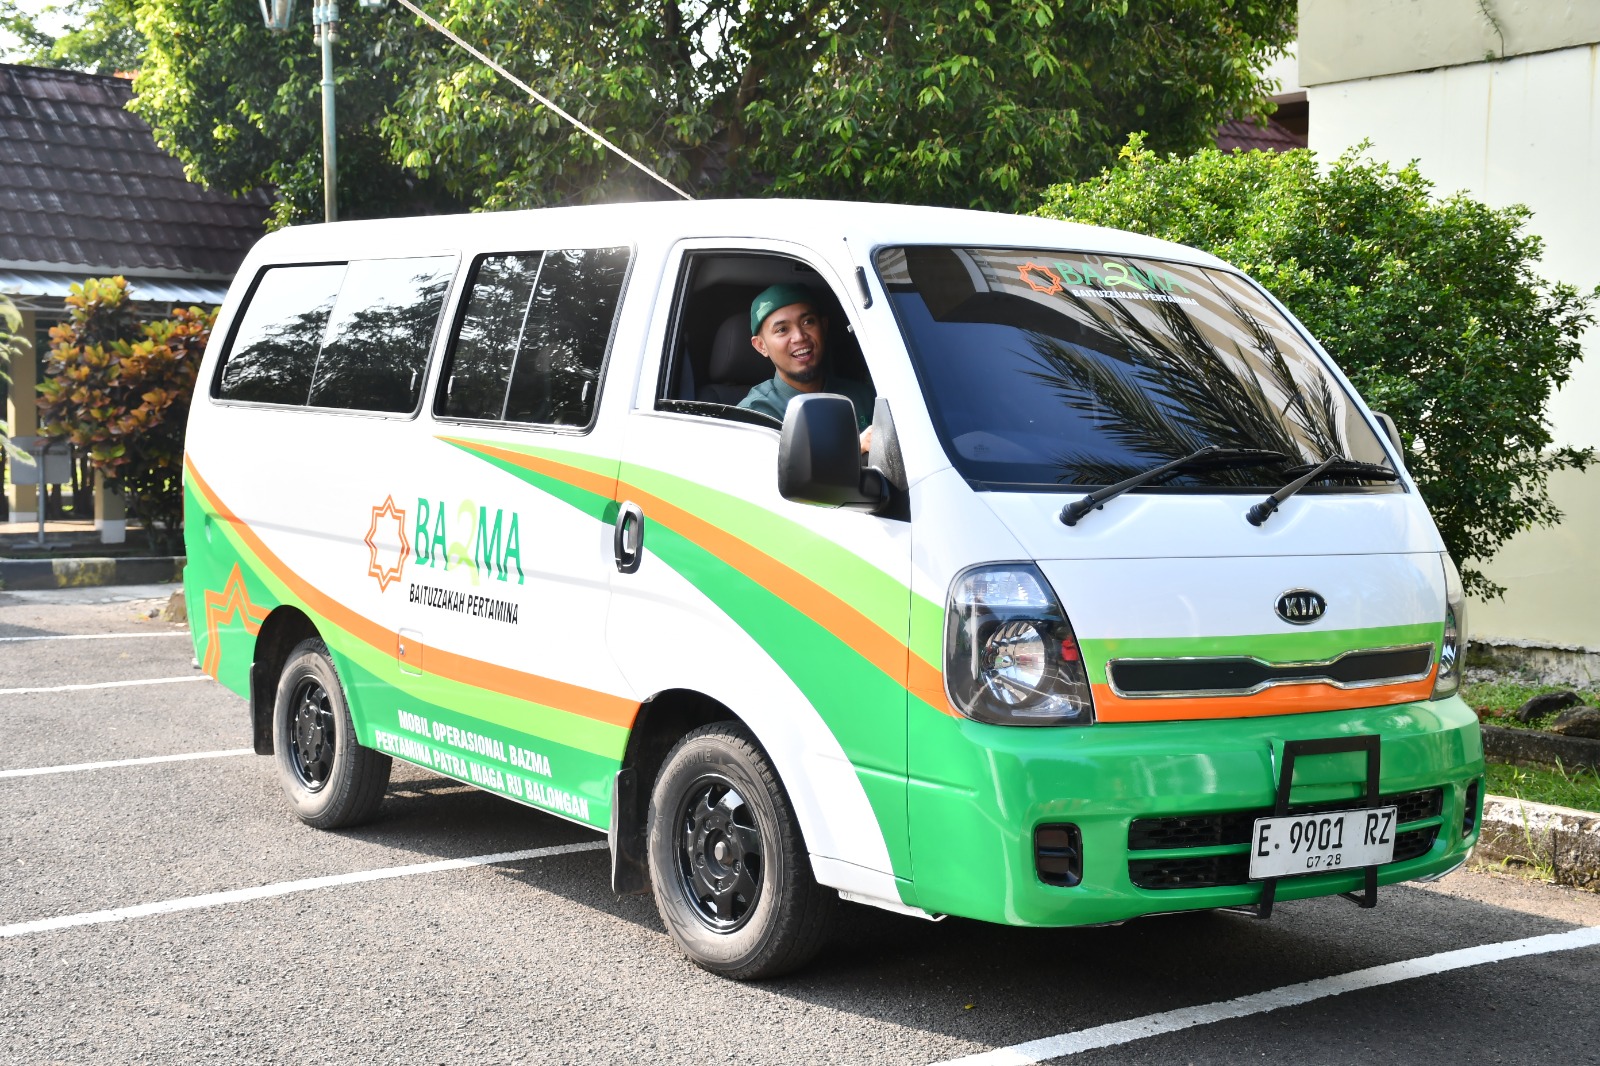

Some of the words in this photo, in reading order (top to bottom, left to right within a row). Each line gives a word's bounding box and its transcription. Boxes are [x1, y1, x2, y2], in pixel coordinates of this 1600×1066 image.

[1071, 289, 1143, 301] BAITUZZAKAH
[1143, 293, 1200, 306] PERTAMINA
[409, 583, 465, 614] BAITUZZAKAH
[466, 594, 519, 625] PERTAMINA
[1284, 596, 1321, 617] KIA
[397, 709, 432, 738] MOBIL
[432, 720, 507, 763] OPERASIONAL
[508, 744, 552, 778] BAZMA
[374, 729, 433, 766] PERTAMINA
[433, 749, 469, 780] PATRA
[469, 762, 506, 792] NIAGA
[505, 773, 523, 797] RU
[524, 779, 590, 821] BALONGAN
[1289, 816, 1345, 854] 9901
[1363, 812, 1393, 846] RZ
